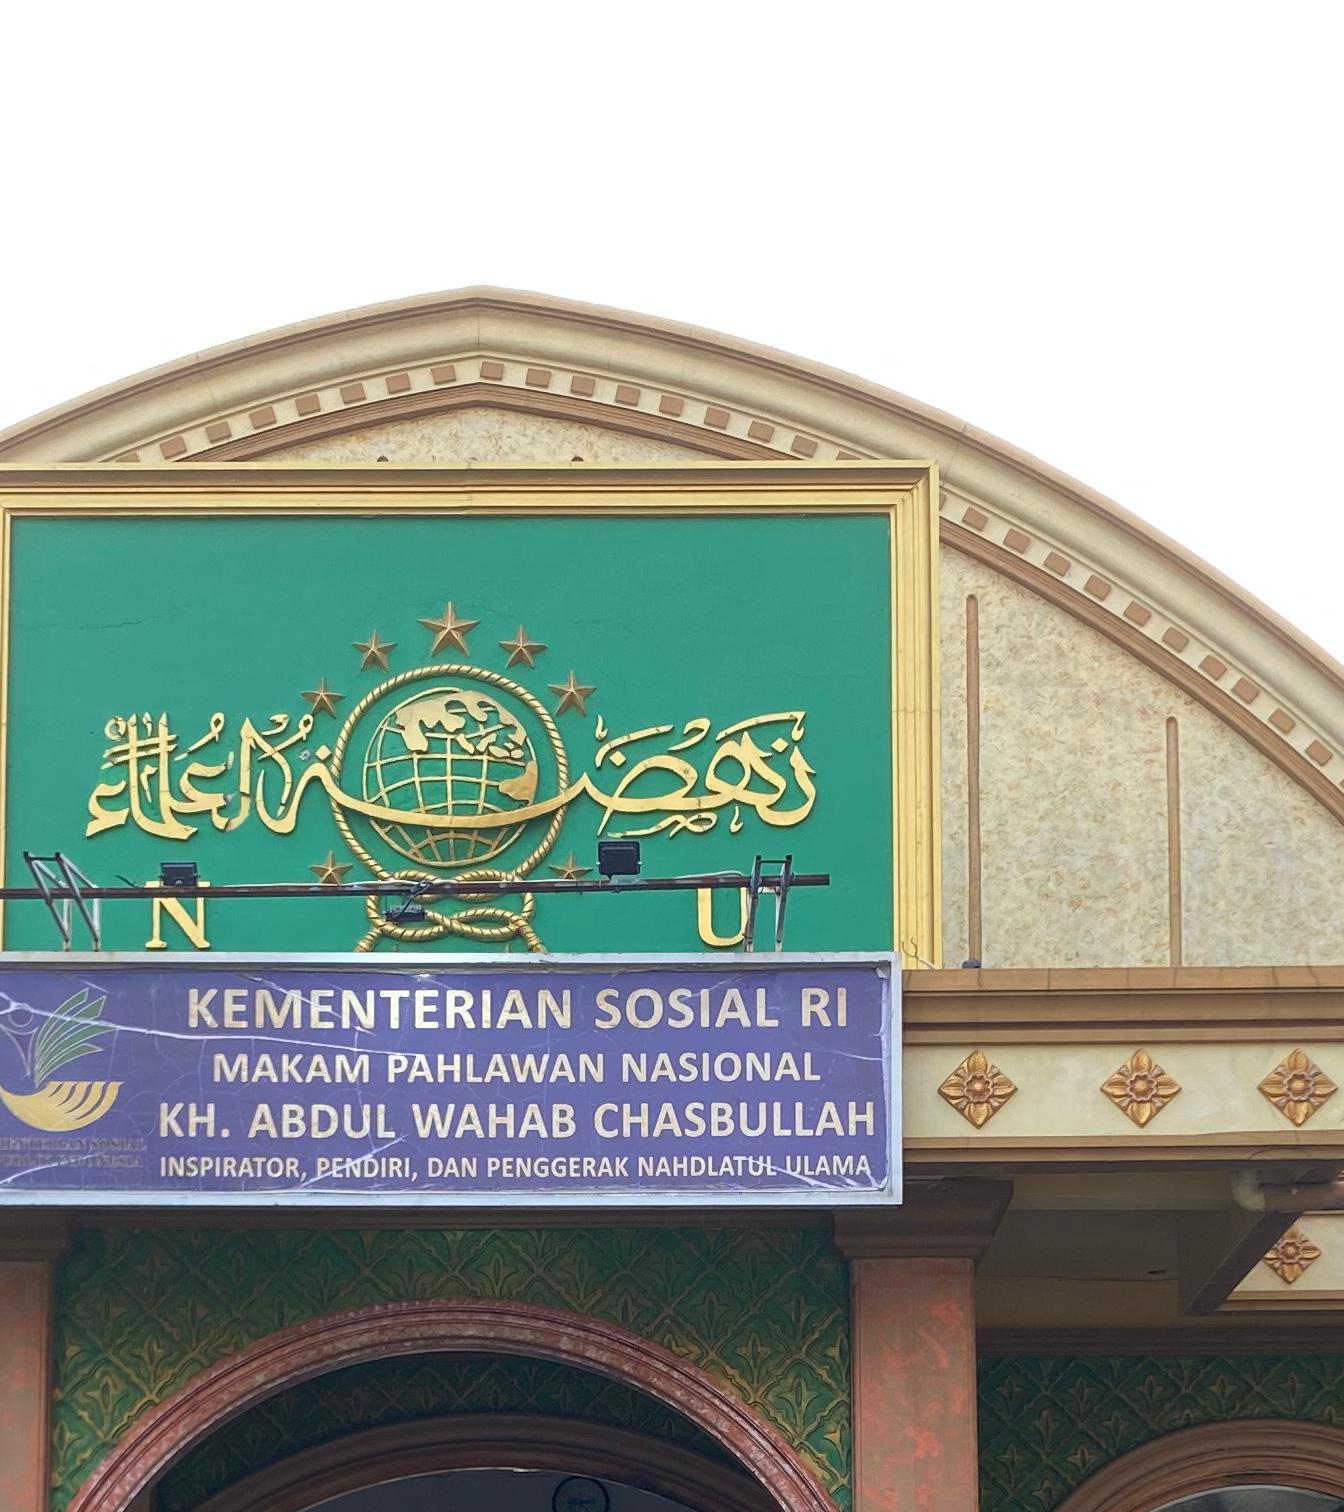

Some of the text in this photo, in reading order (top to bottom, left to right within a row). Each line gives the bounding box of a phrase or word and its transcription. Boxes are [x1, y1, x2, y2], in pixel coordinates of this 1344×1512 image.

[145, 881, 752, 950] N U
[187, 987, 848, 1029] KEMENTERIAN SOSIAL RI
[212, 1052, 822, 1084] MAKAM PAHLAWAN NASIONAL
[158, 1101, 875, 1139] KH. ABDUL WAHAB CHASBULLAH
[159, 1154, 871, 1182] INSPIRATOR, PENDIRI, DAN PENGGERAK NAHDLATUL ULAMA
